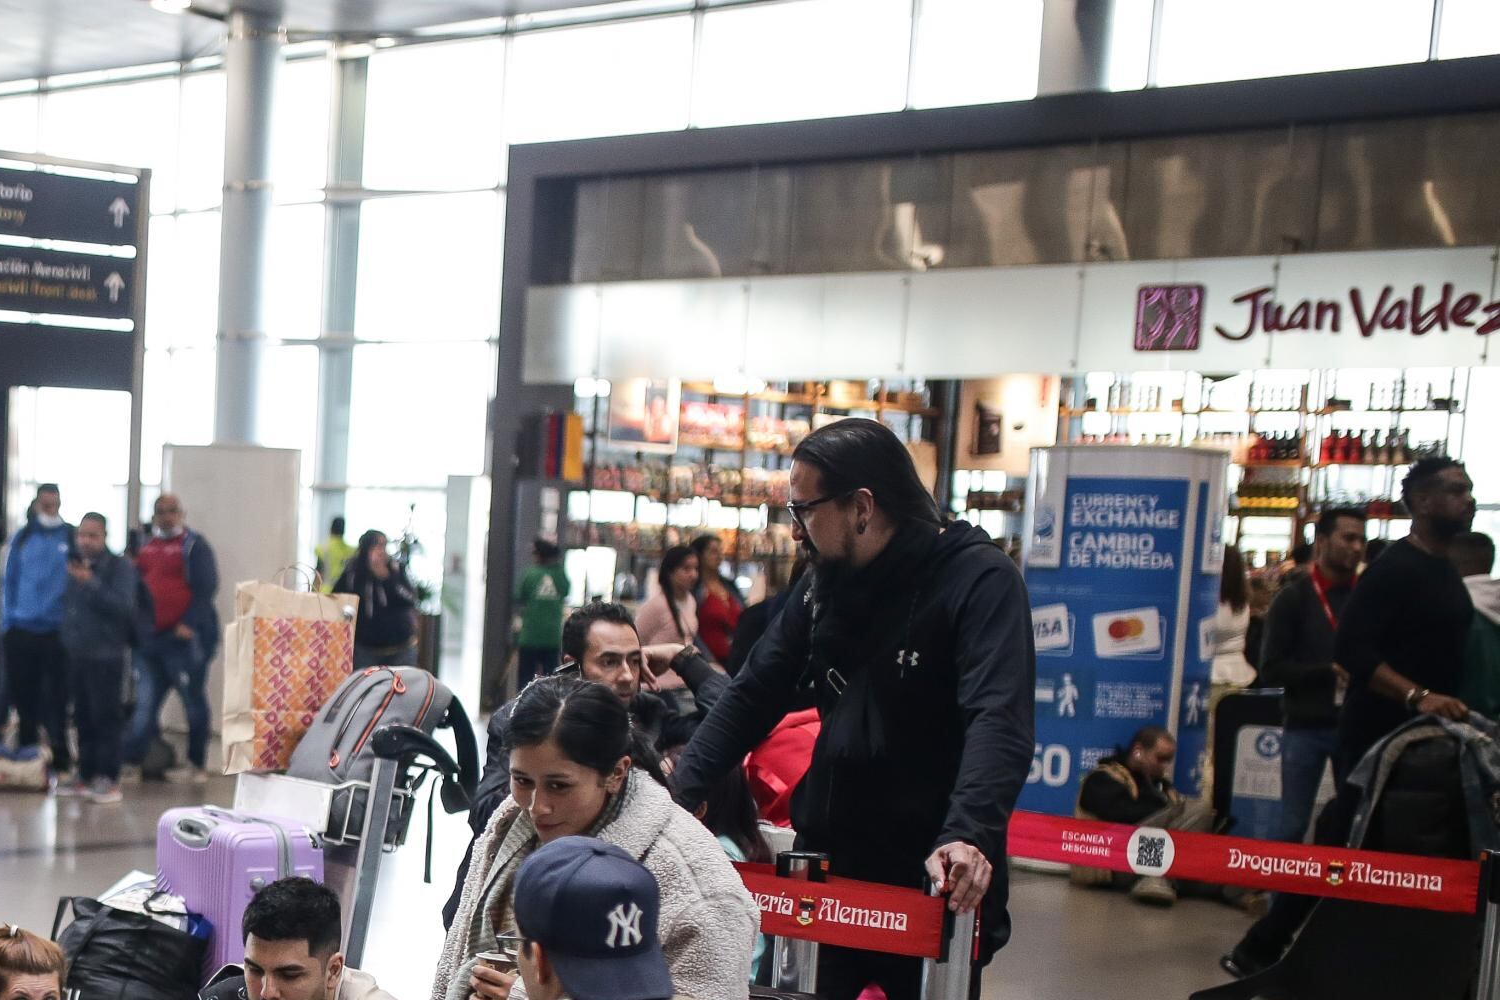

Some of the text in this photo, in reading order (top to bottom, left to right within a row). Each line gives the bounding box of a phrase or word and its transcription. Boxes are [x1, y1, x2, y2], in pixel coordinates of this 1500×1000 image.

[1214, 286, 1342, 341] Juan
[1071, 492, 1160, 509] CURRENCY
[1071, 507, 1181, 529] EXCHANGE
[1069, 530, 1155, 552] CAMBIO
[1068, 551, 1091, 568] DE
[1095, 551, 1175, 570] MONEDA
[1062, 830, 1114, 846] ESCANEA Y
[1061, 842, 1111, 857] DESCUBRE
[1228, 848, 1443, 892] Droguería Alemana
[817, 897, 908, 932] Alemana
